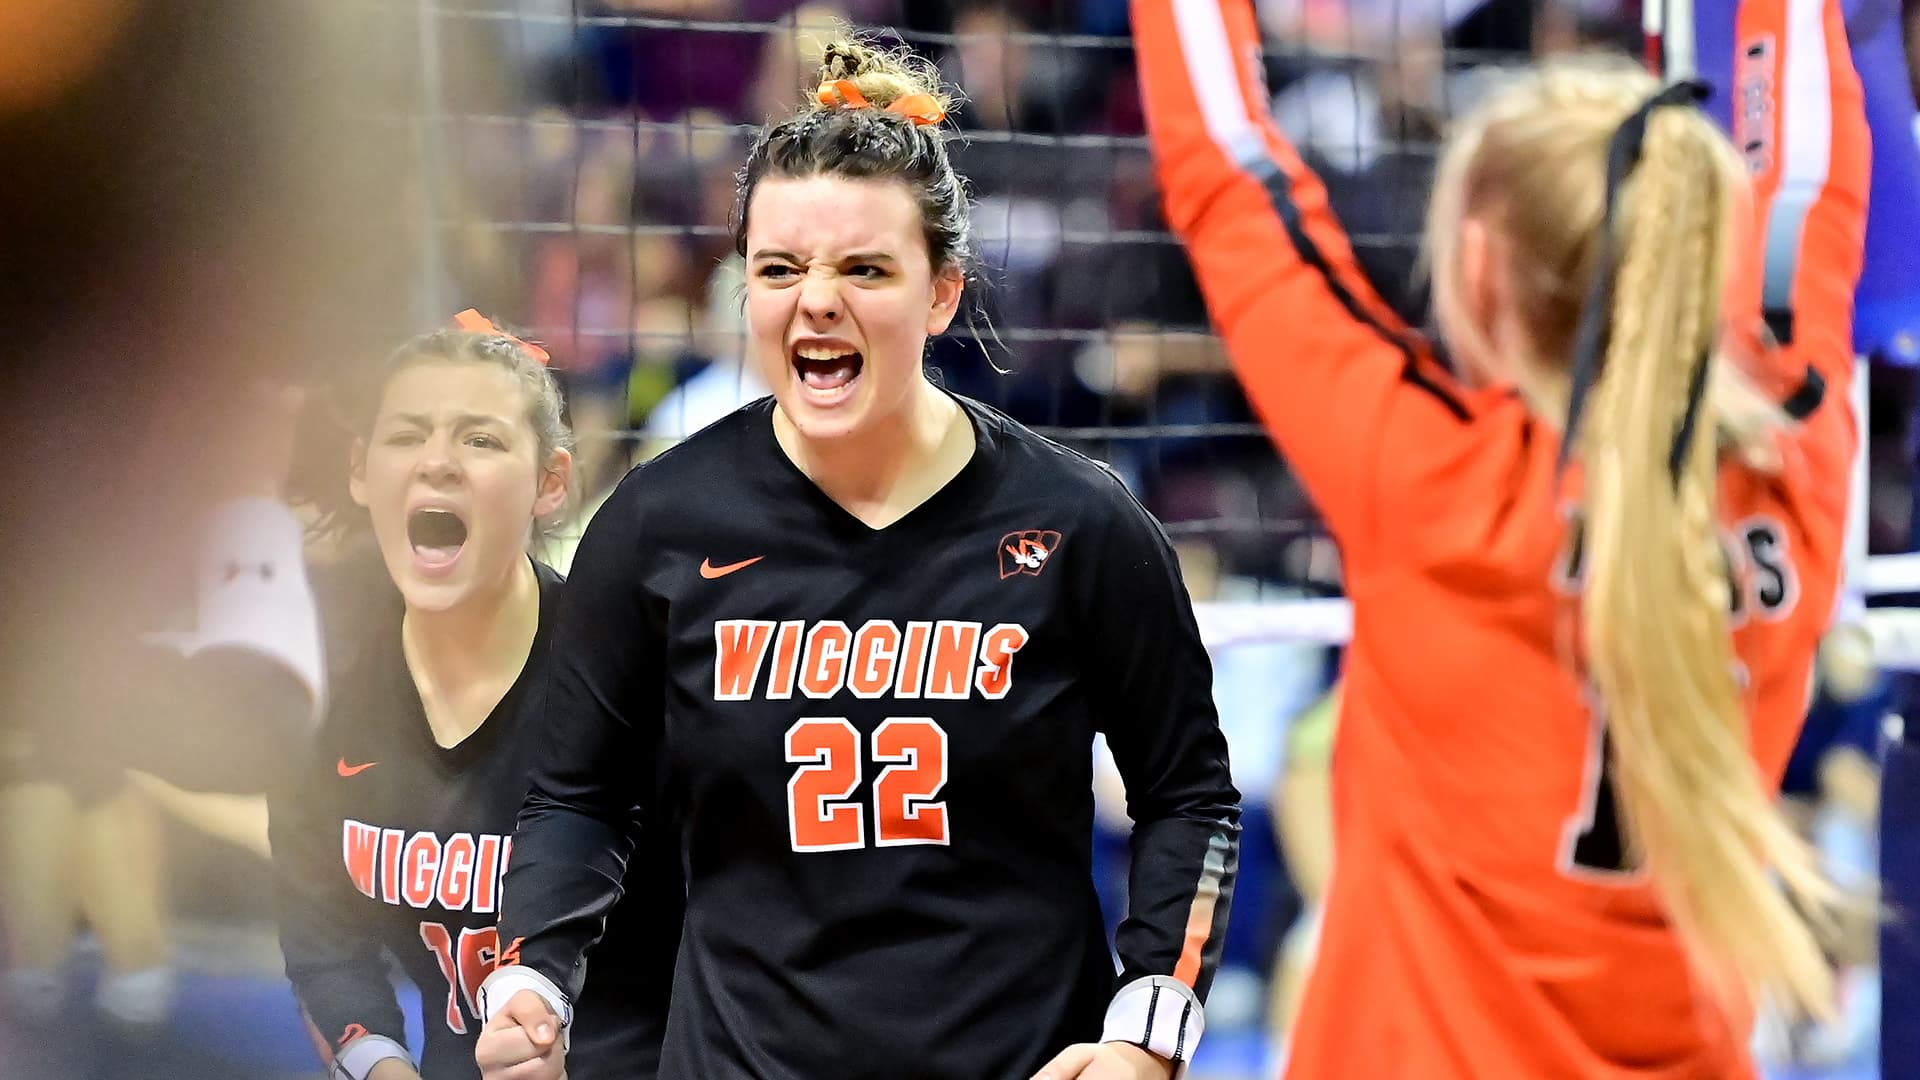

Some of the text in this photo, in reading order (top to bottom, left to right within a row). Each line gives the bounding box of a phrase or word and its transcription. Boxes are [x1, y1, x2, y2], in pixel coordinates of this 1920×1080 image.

[714, 619, 1029, 700] WIGGINS
[784, 717, 950, 853] 22
[343, 819, 512, 913] WIGGI
